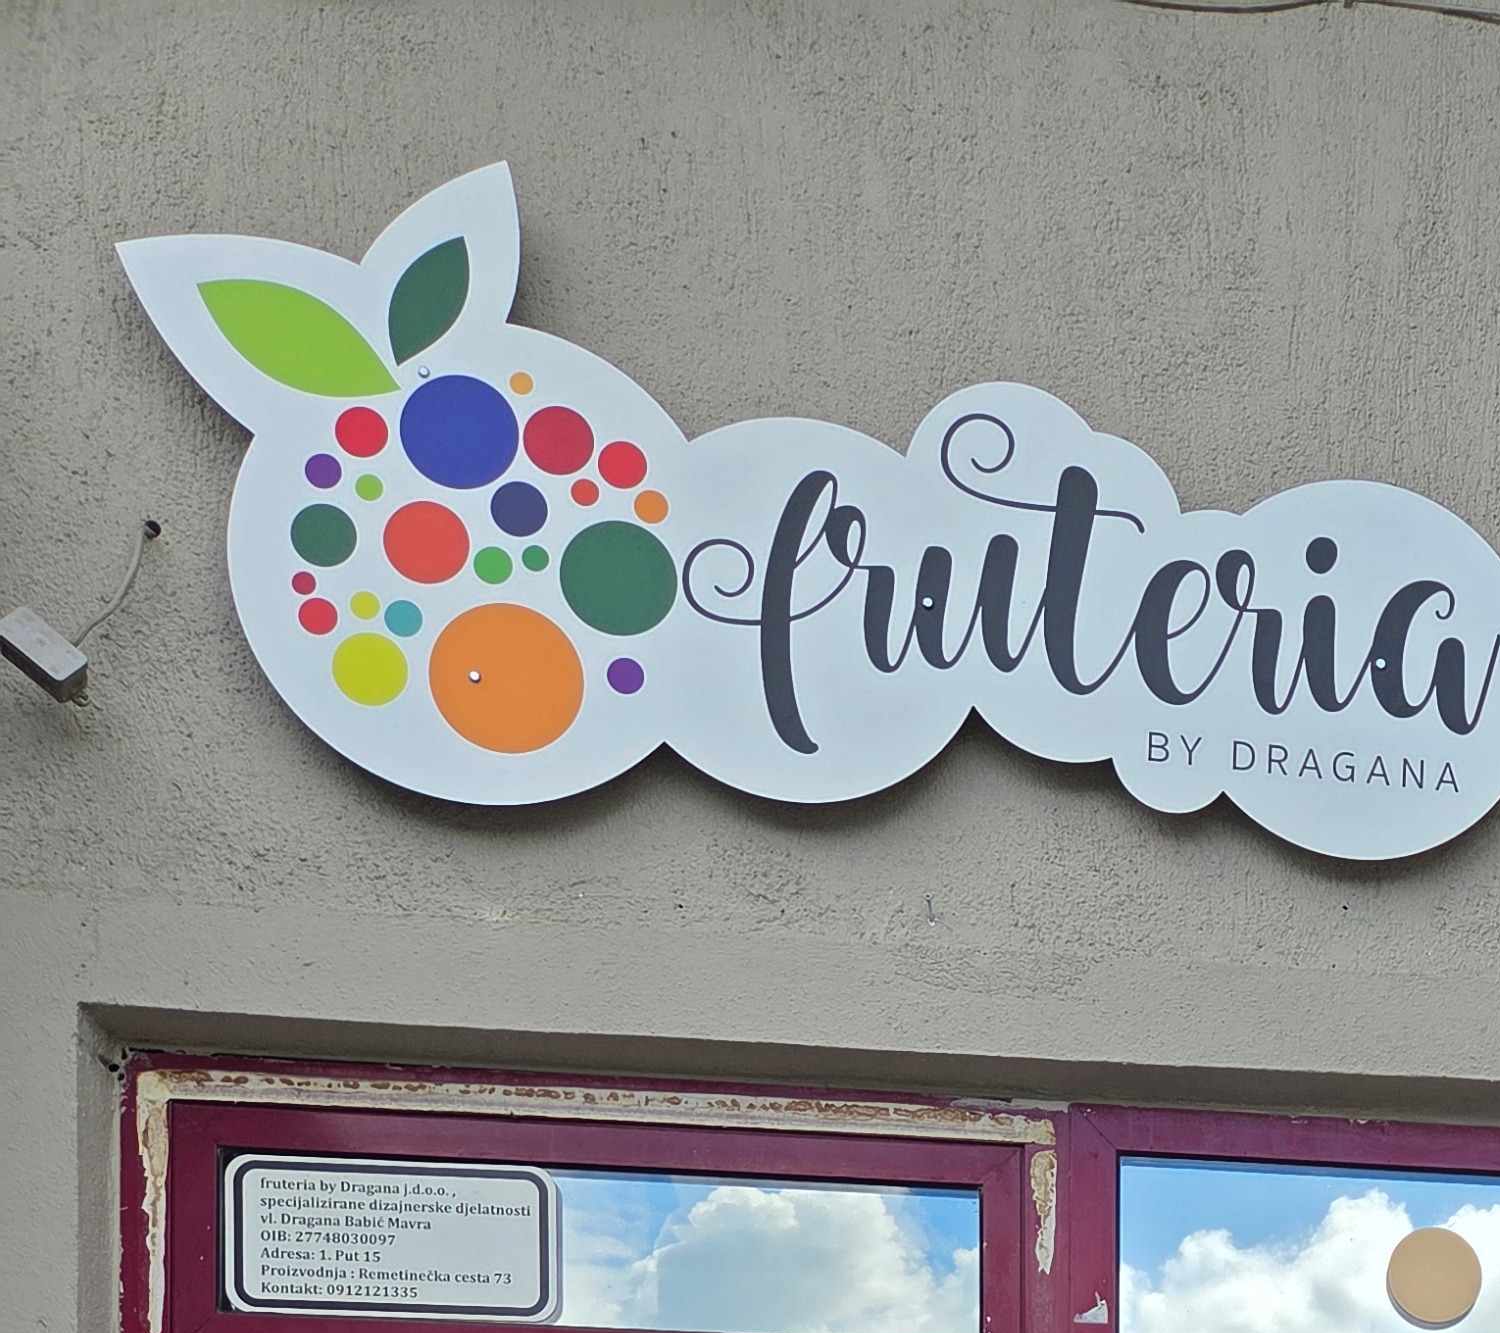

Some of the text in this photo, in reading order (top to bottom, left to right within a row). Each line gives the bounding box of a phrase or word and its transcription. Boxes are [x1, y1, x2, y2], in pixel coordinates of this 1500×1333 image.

[1147, 731, 1460, 793] BY DRAGANA
[260, 1177, 316, 1191] fruteria
[319, 1179, 337, 1195] by
[340, 1180, 400, 1196] Dragana
[260, 1195, 531, 1217] specijalizirane dizajnerske djelatnosti
[260, 1212, 431, 1230] vl. Dragana Babić Mavra
[260, 1230, 396, 1246] OIB: 27748030097
[260, 1246, 381, 1263] Adresa: 1. Put 15
[261, 1264, 347, 1281] Proizvodnja
[359, 1267, 451, 1282] Remetinečka
[454, 1273, 490, 1284] cesta
[493, 1273, 512, 1285] 73
[261, 1281, 418, 1299] Kontakt: 0912121335
